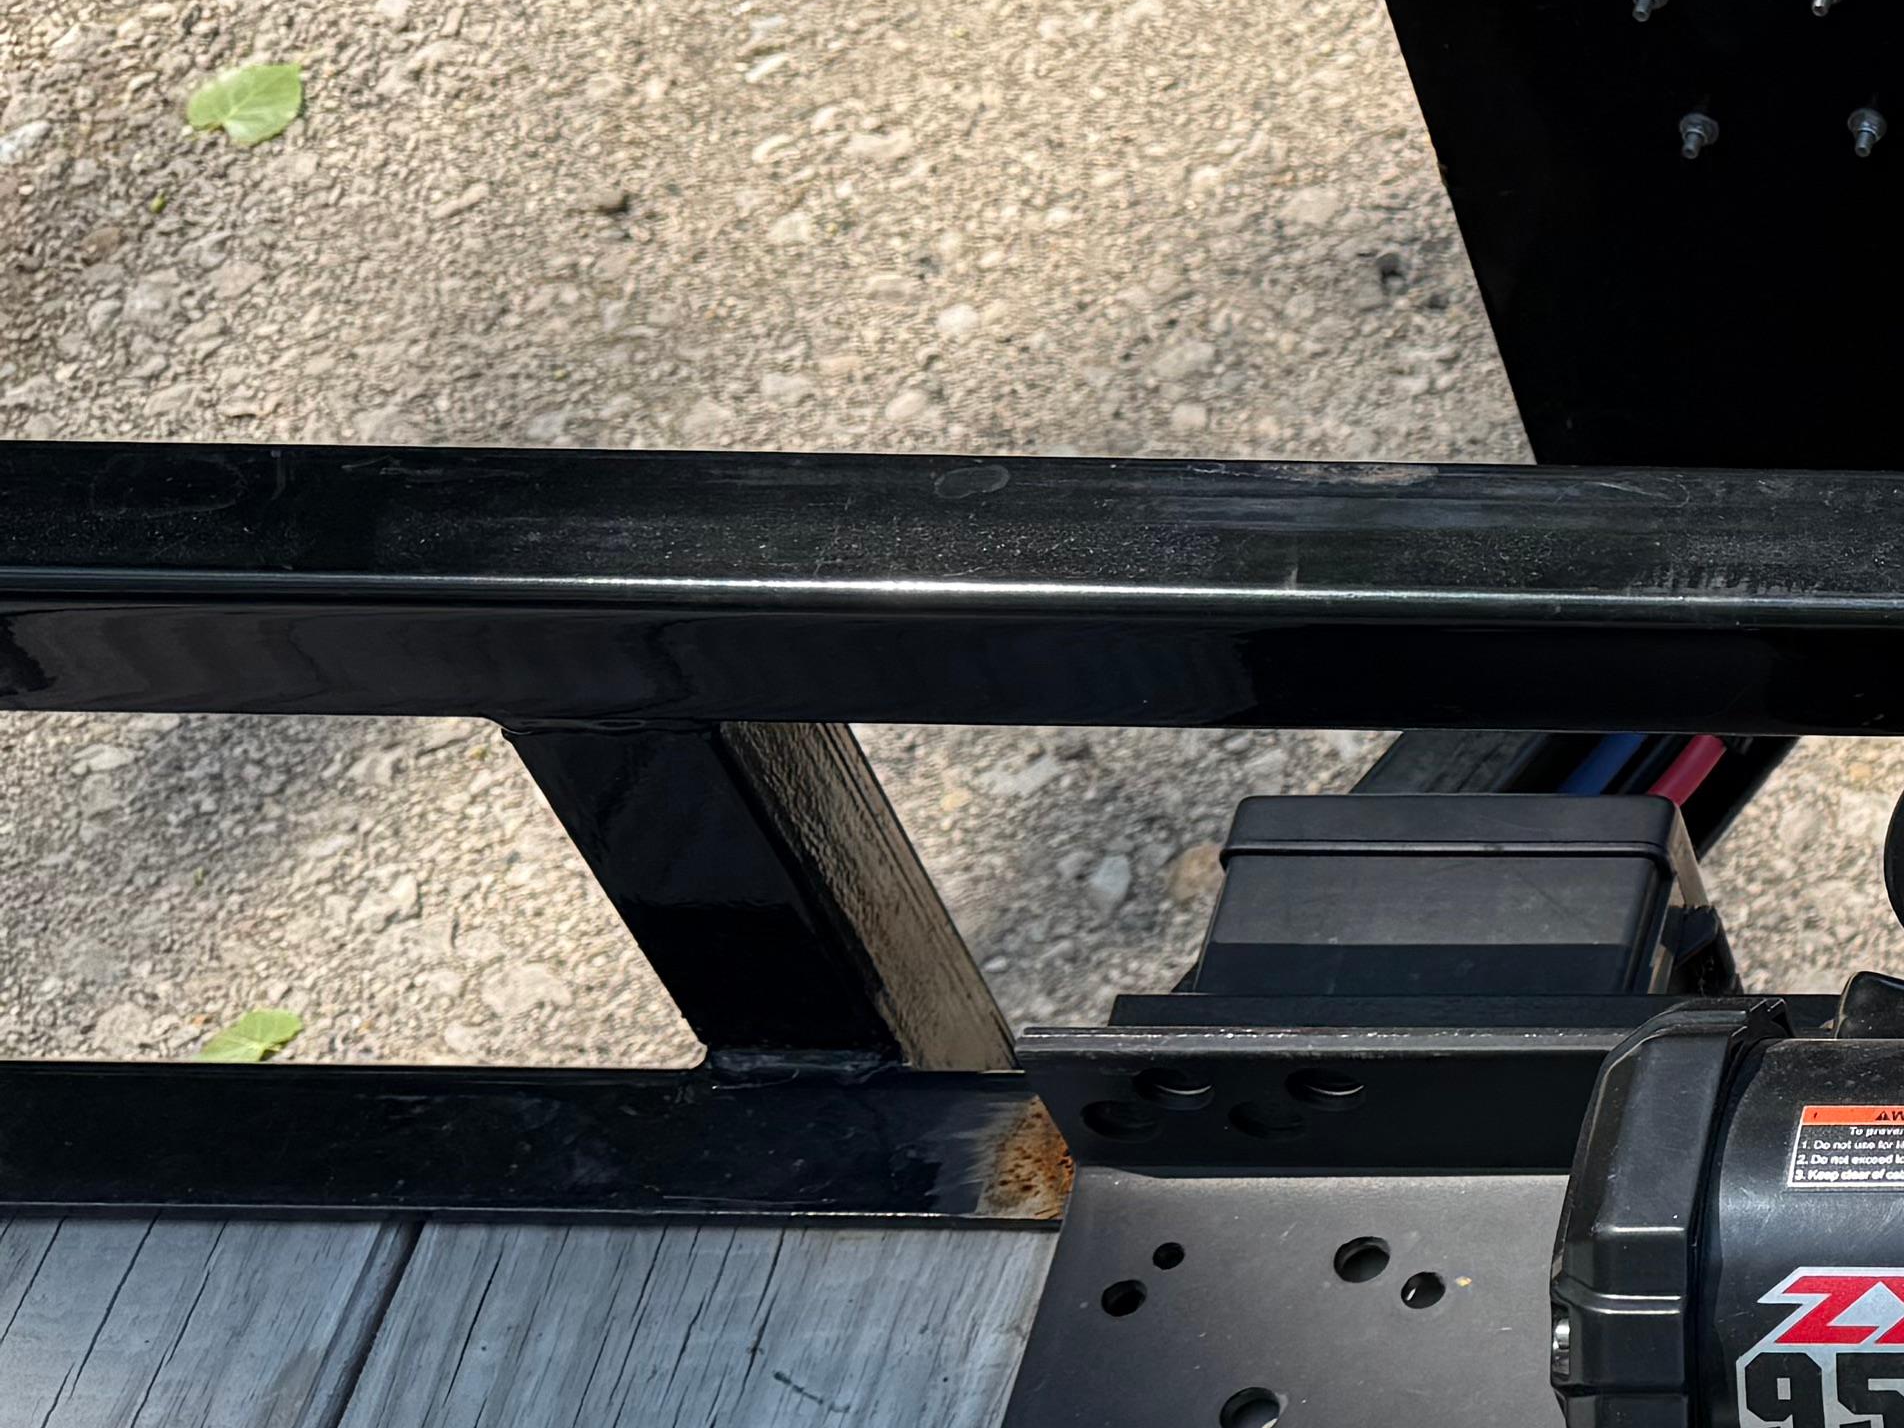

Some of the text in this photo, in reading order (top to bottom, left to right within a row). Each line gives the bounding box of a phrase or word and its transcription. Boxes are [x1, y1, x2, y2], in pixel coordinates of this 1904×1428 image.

[1850, 1126, 1864, 1136] To
[1801, 1140, 1811, 1150] 1.
[1814, 1140, 1831, 1150] Do
[1833, 1140, 1852, 1150] not
[1854, 1141, 1876, 1150] use
[1878, 1140, 1894, 1150] for
[1797, 1154, 1808, 1165] 2.
[1811, 1154, 1829, 1165] Do
[1830, 1154, 1849, 1165] not
[1851, 1154, 1893, 1165] exceed
[1808, 1169, 1840, 1182] Keep
[1841, 1169, 1871, 1181] clear
[1872, 1169, 1885, 1181] of
